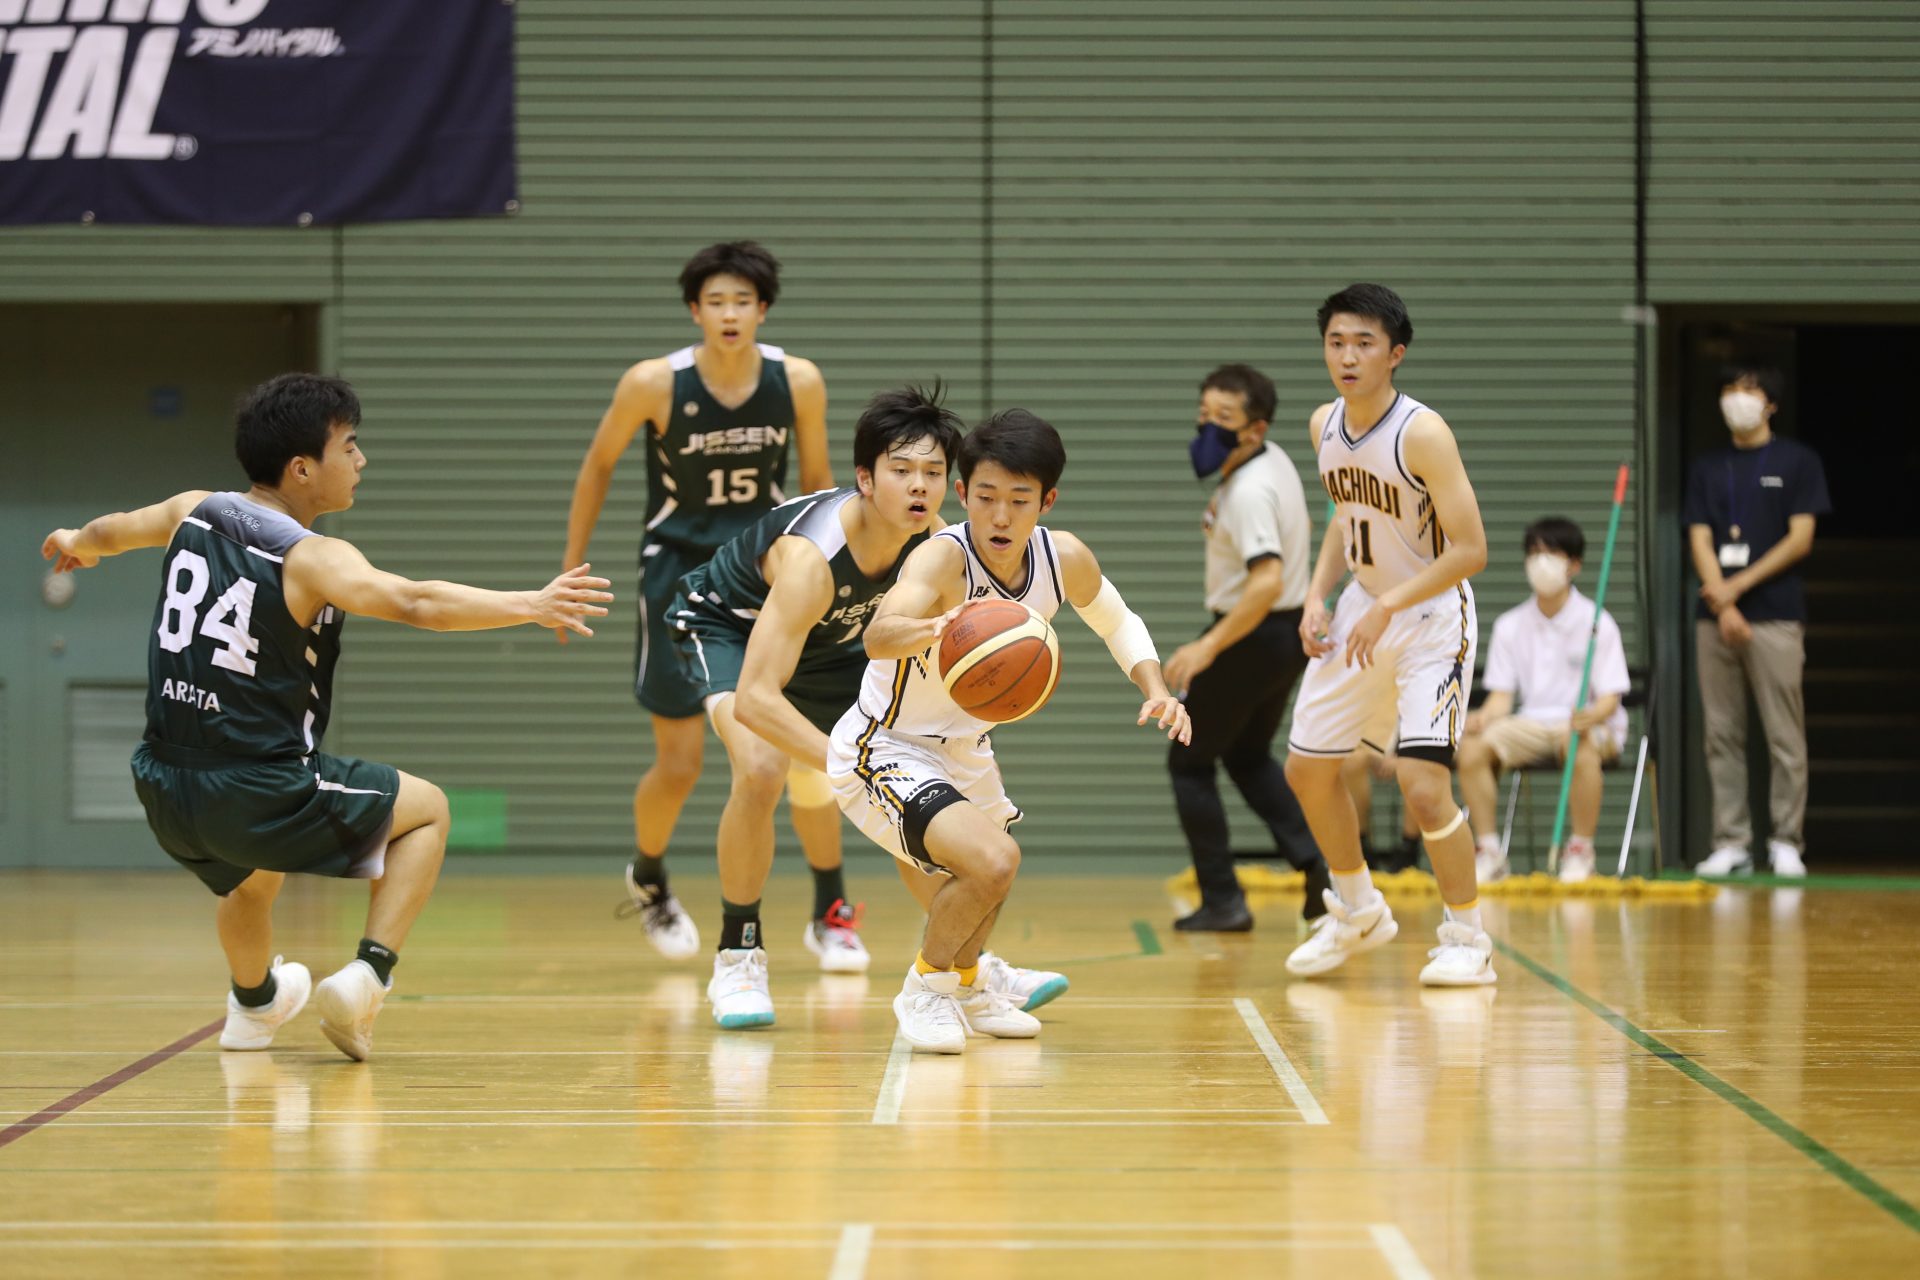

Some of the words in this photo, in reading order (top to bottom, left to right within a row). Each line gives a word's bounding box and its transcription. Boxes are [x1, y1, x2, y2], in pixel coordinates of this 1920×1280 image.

[679, 425, 788, 455] JISSEN
[706, 468, 760, 506] 15
[157, 549, 260, 677] 84
[160, 678, 221, 712] ARATA
